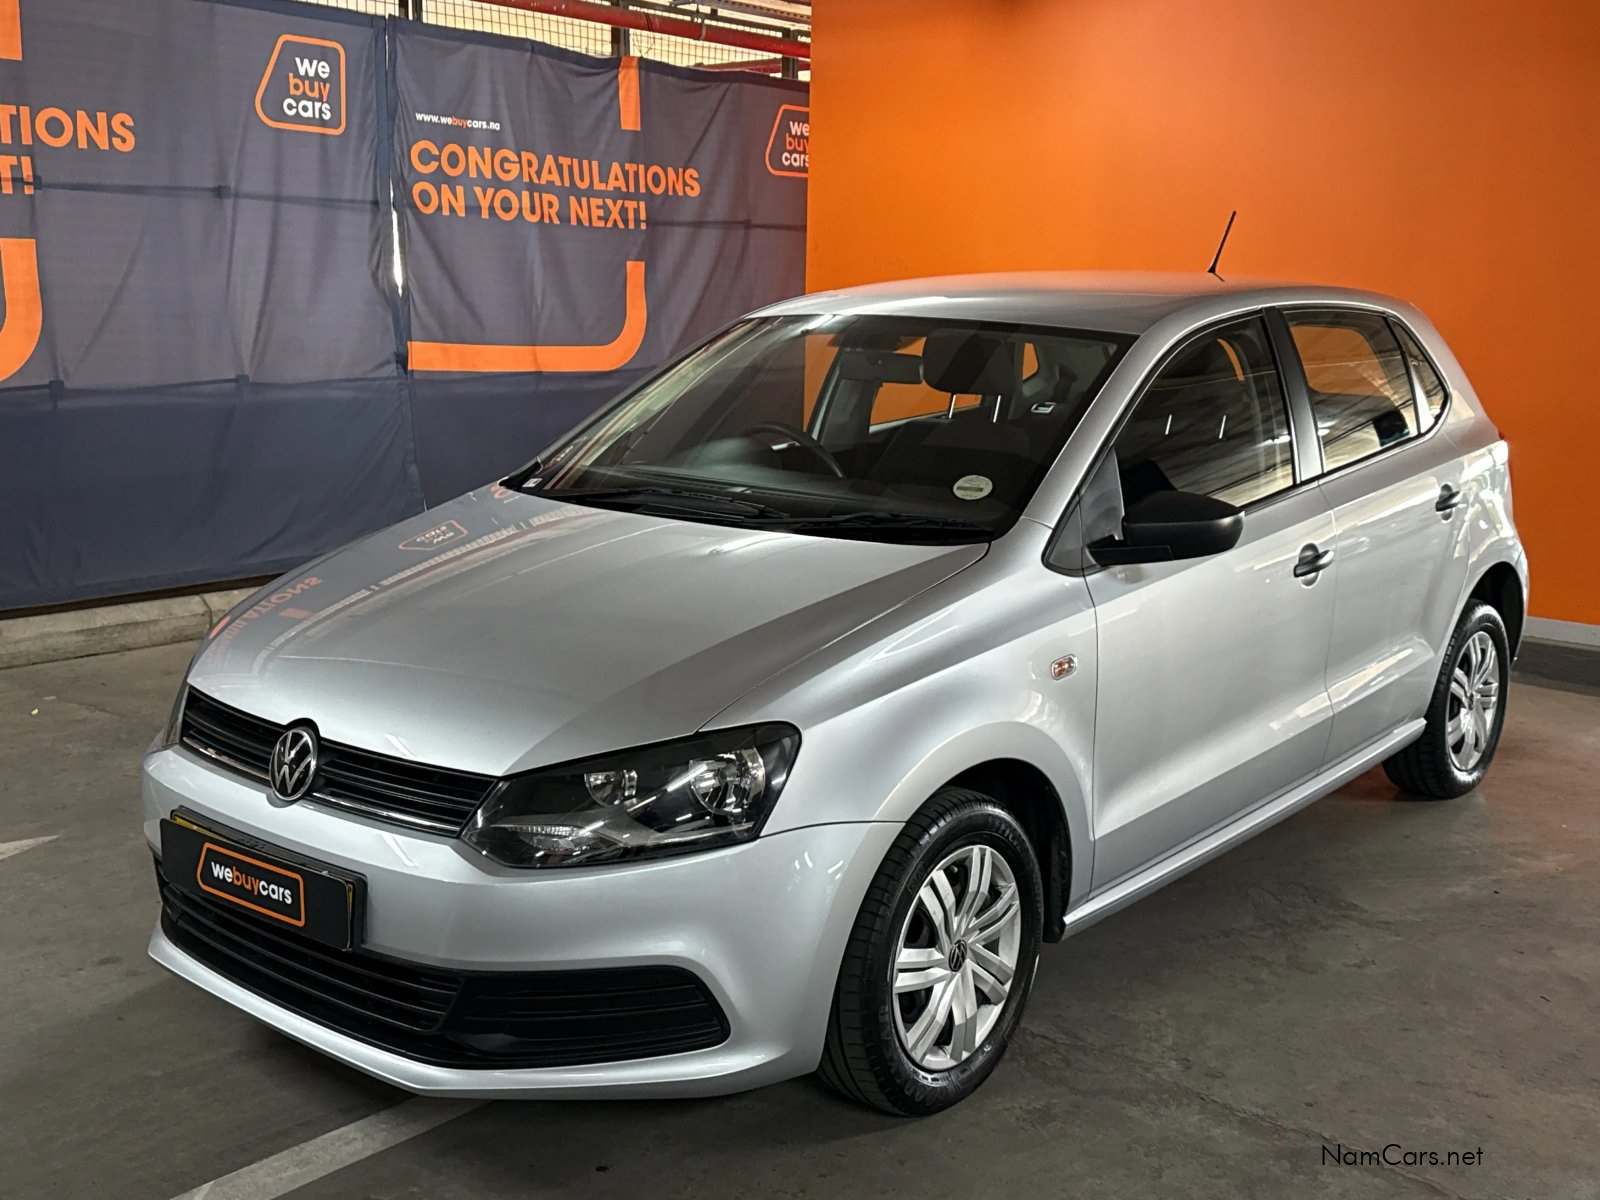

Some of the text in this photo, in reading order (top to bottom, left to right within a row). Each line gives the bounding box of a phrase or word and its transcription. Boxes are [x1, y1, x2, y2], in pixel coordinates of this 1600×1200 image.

[295, 57, 330, 78] we
[288, 72, 330, 102] buy
[283, 98, 331, 120] cars
[415, 112, 500, 130] www.webuycars.na
[0, 104, 136, 152] TIONS
[790, 121, 809, 136] we
[411, 140, 701, 197] CONGRATULATIONS
[412, 181, 647, 230] ON YOUR NEXT!
[272, 729, 314, 797] VW
[211, 861, 292, 905] webuycars
